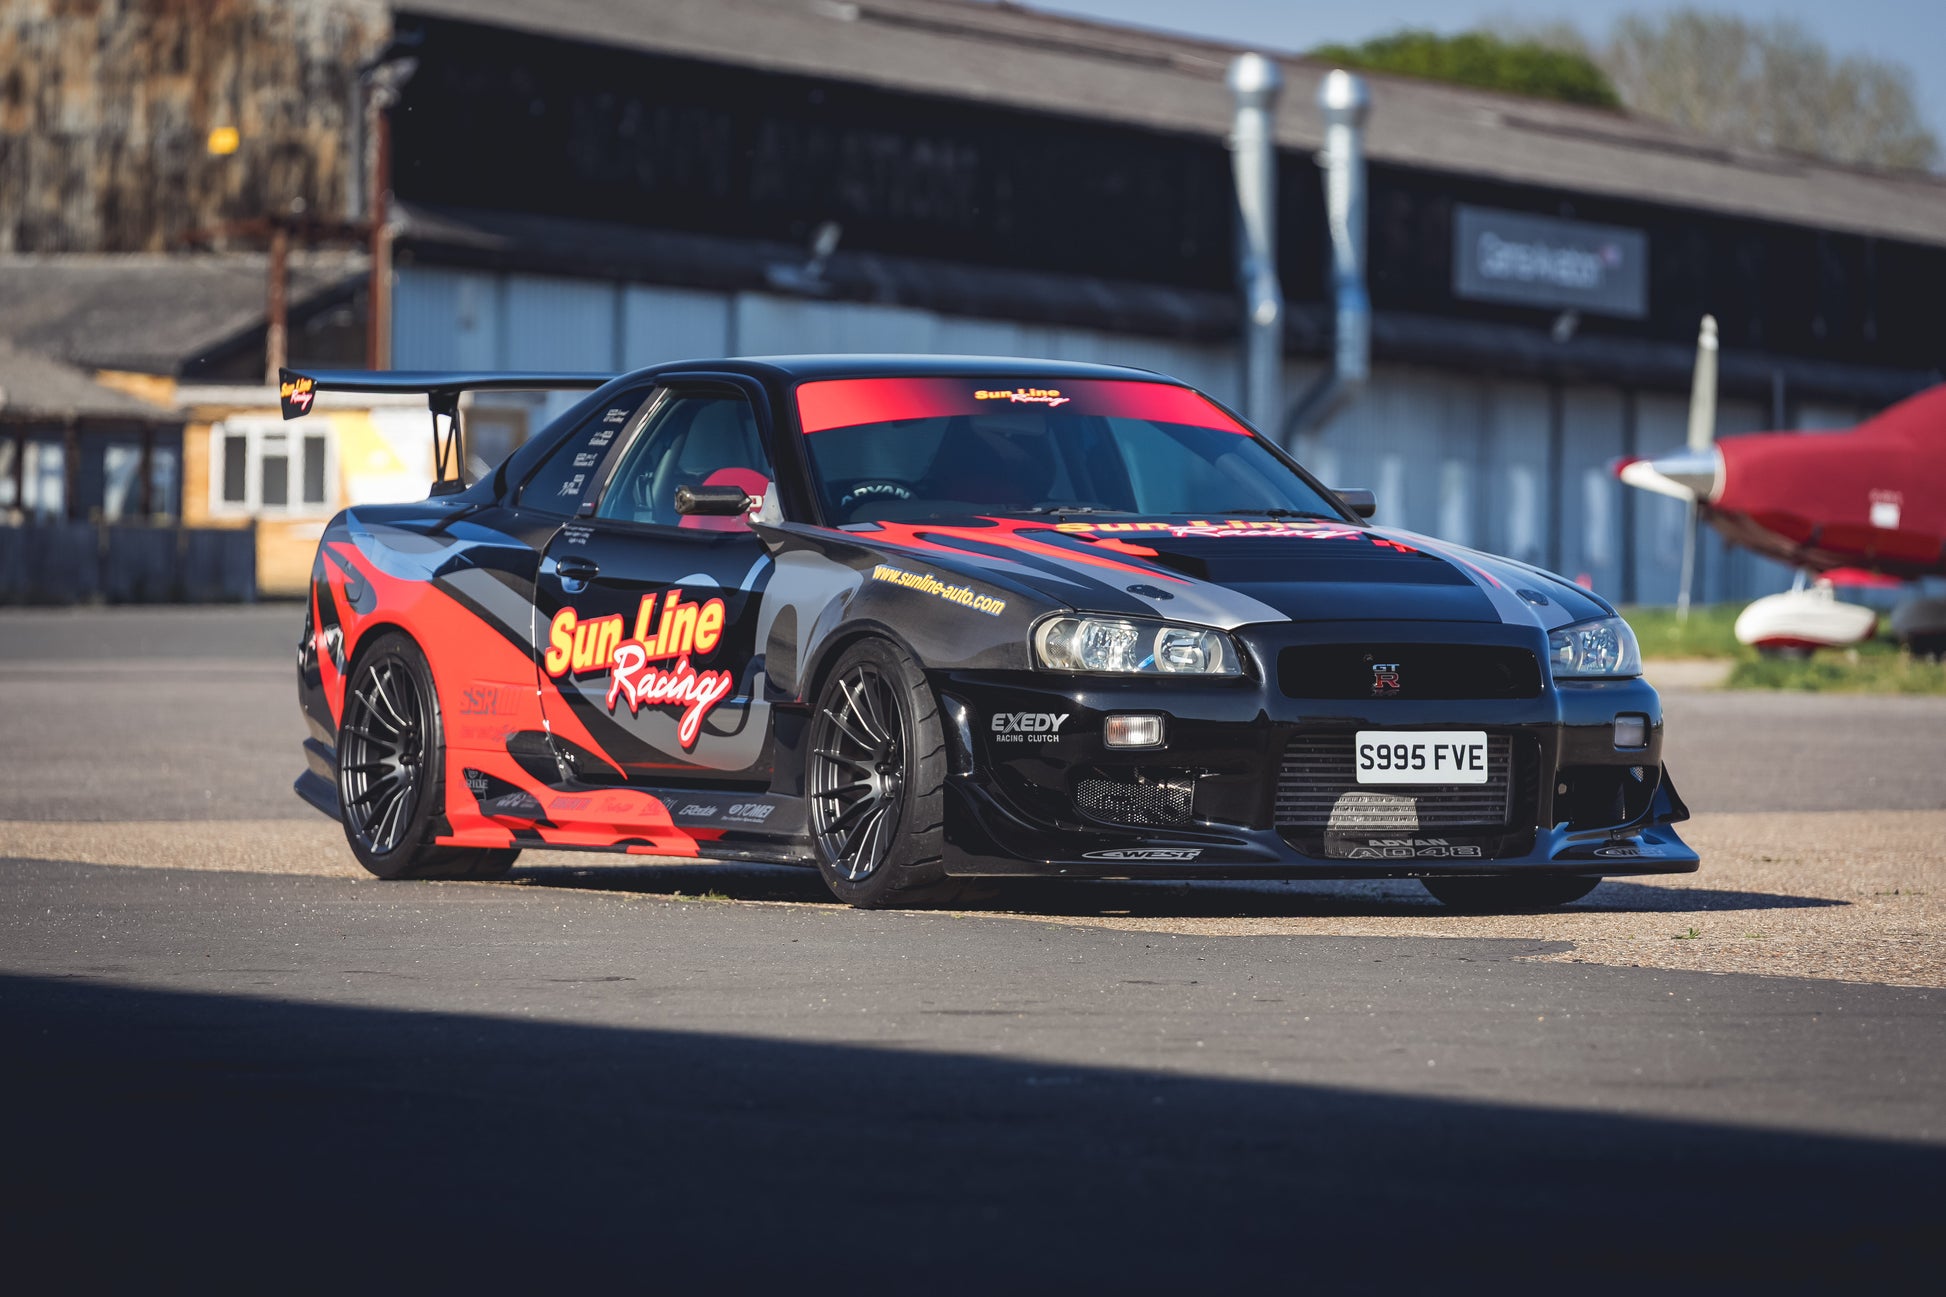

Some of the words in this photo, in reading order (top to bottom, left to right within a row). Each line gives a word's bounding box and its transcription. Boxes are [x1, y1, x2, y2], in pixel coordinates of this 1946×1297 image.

[974, 389, 1013, 400] Sun
[1017, 387, 1061, 398] Line
[1010, 393, 1070, 407] Racing
[1055, 521, 1170, 533] Sun
[1168, 526, 1362, 540] Racing
[872, 564, 1006, 616] www.sunline-auto.com
[545, 607, 624, 677] Sun
[634, 589, 725, 661] Line
[1373, 663, 1400, 672] GT
[1374, 672, 1401, 688] R
[606, 640, 732, 747] Racing
[991, 712, 1070, 733] EXEDY
[996, 734, 1024, 742] RACING
[1027, 734, 1060, 742] CLUTCH
[1360, 744, 1426, 770] S995
[1434, 744, 1484, 770] FVE
[1368, 838, 1450, 847] ADVAN
